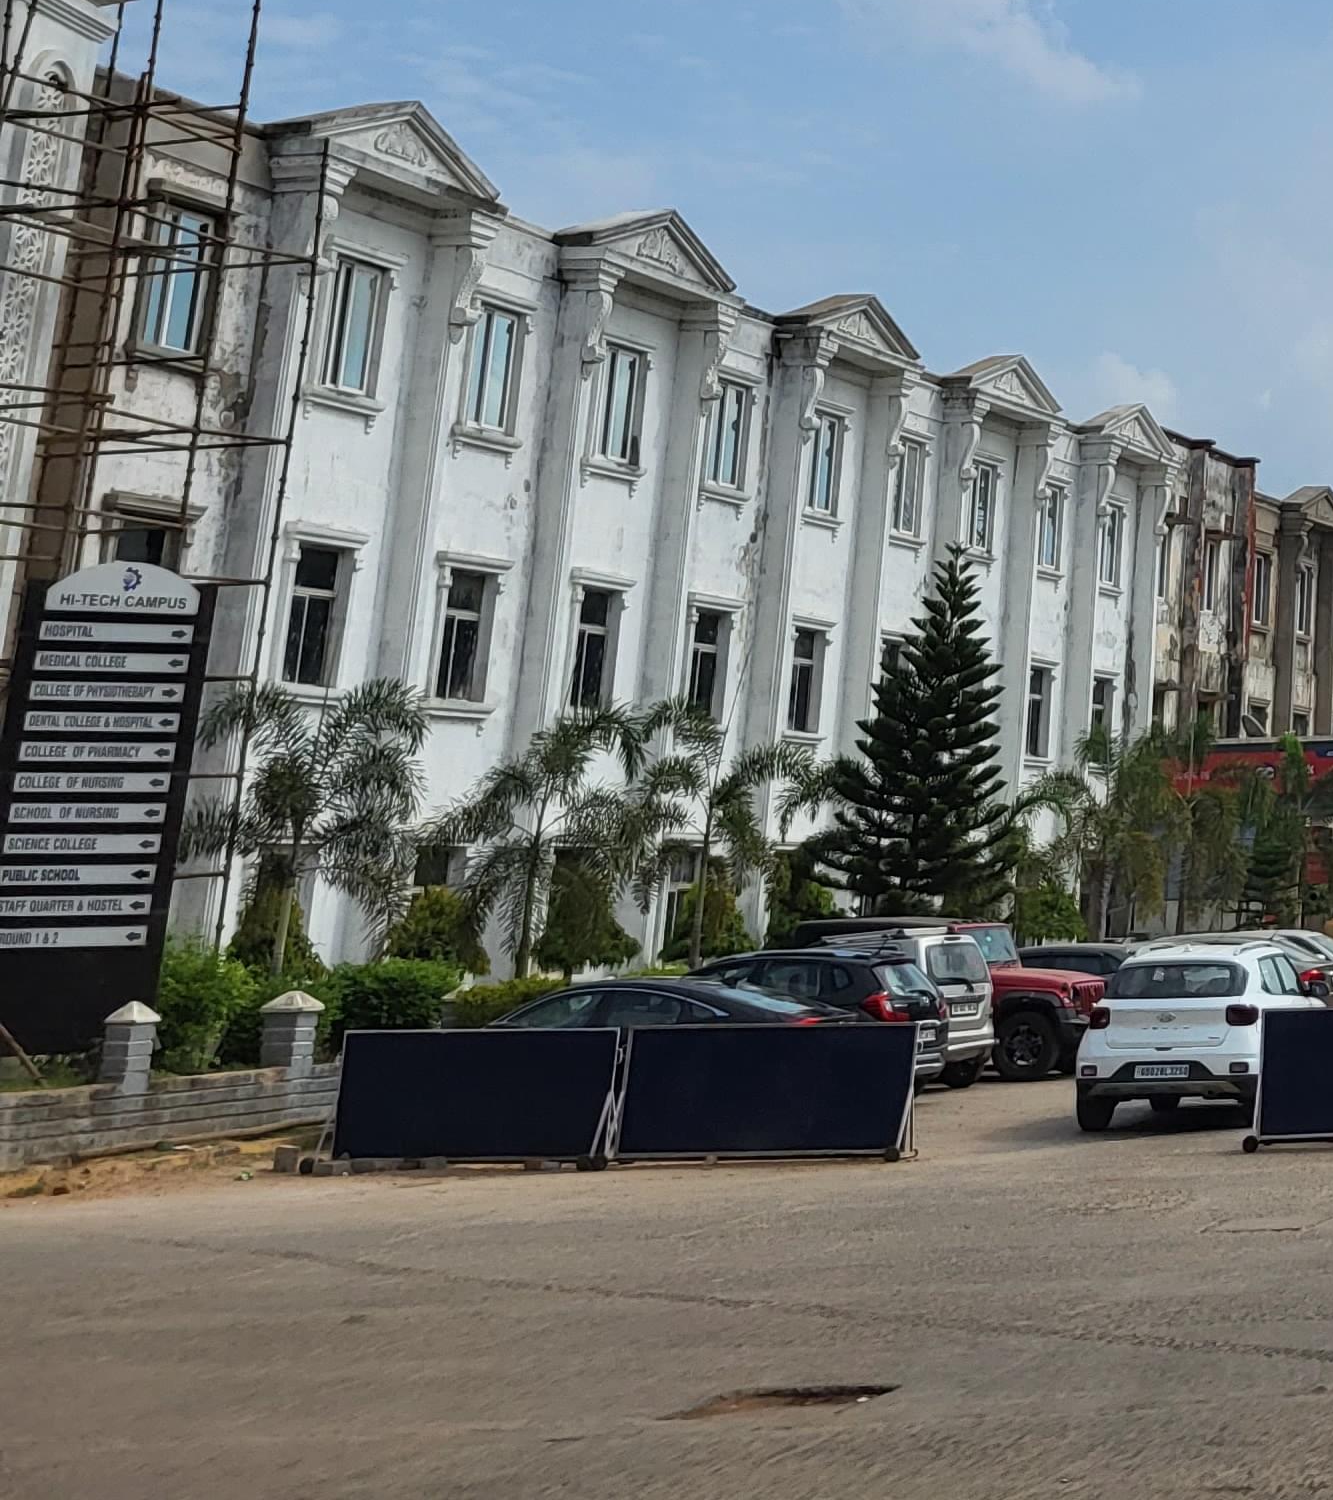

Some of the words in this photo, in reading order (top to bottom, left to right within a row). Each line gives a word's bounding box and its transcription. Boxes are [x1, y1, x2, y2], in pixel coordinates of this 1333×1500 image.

[60, 593, 121, 607] HI-TECH
[124, 595, 187, 610] CAMPUS
[44, 625, 94, 638] HOSPITAL
[39, 654, 81, 667] MEDICAL
[85, 655, 128, 668] COLLEGE
[33, 684, 71, 697] COLLEGE
[74, 684, 85, 697] OF
[86, 685, 155, 698] PHYSIOTHERAPY
[29, 715, 60, 727] DENTAL
[64, 716, 102, 728] COLLEGE
[104, 716, 110, 728] &
[113, 716, 153, 728] HOSPITAL
[24, 745, 67, 757] COLLEGE
[72, 745, 84, 758] OF
[88, 746, 142, 758] PHARMACY
[18, 776, 61, 788] COLLEGE
[66, 776, 79, 788] OF
[81, 776, 124, 788] NURSING
[13, 807, 52, 819] SCHOOL
[59, 807, 73, 819] OF
[75, 807, 119, 819] NURSING
[7, 838, 51, 850] SCIENCE
[53, 838, 98, 850] COLLEGE
[2, 869, 38, 881] PUBLIC
[40, 868, 80, 881] SCHOOL
[29, 900, 74, 912] QUARTER
[76, 900, 83, 911] &
[87, 899, 122, 911] HOSTEL
[42, 932, 49, 944] &
[52, 931, 59, 944] 2
